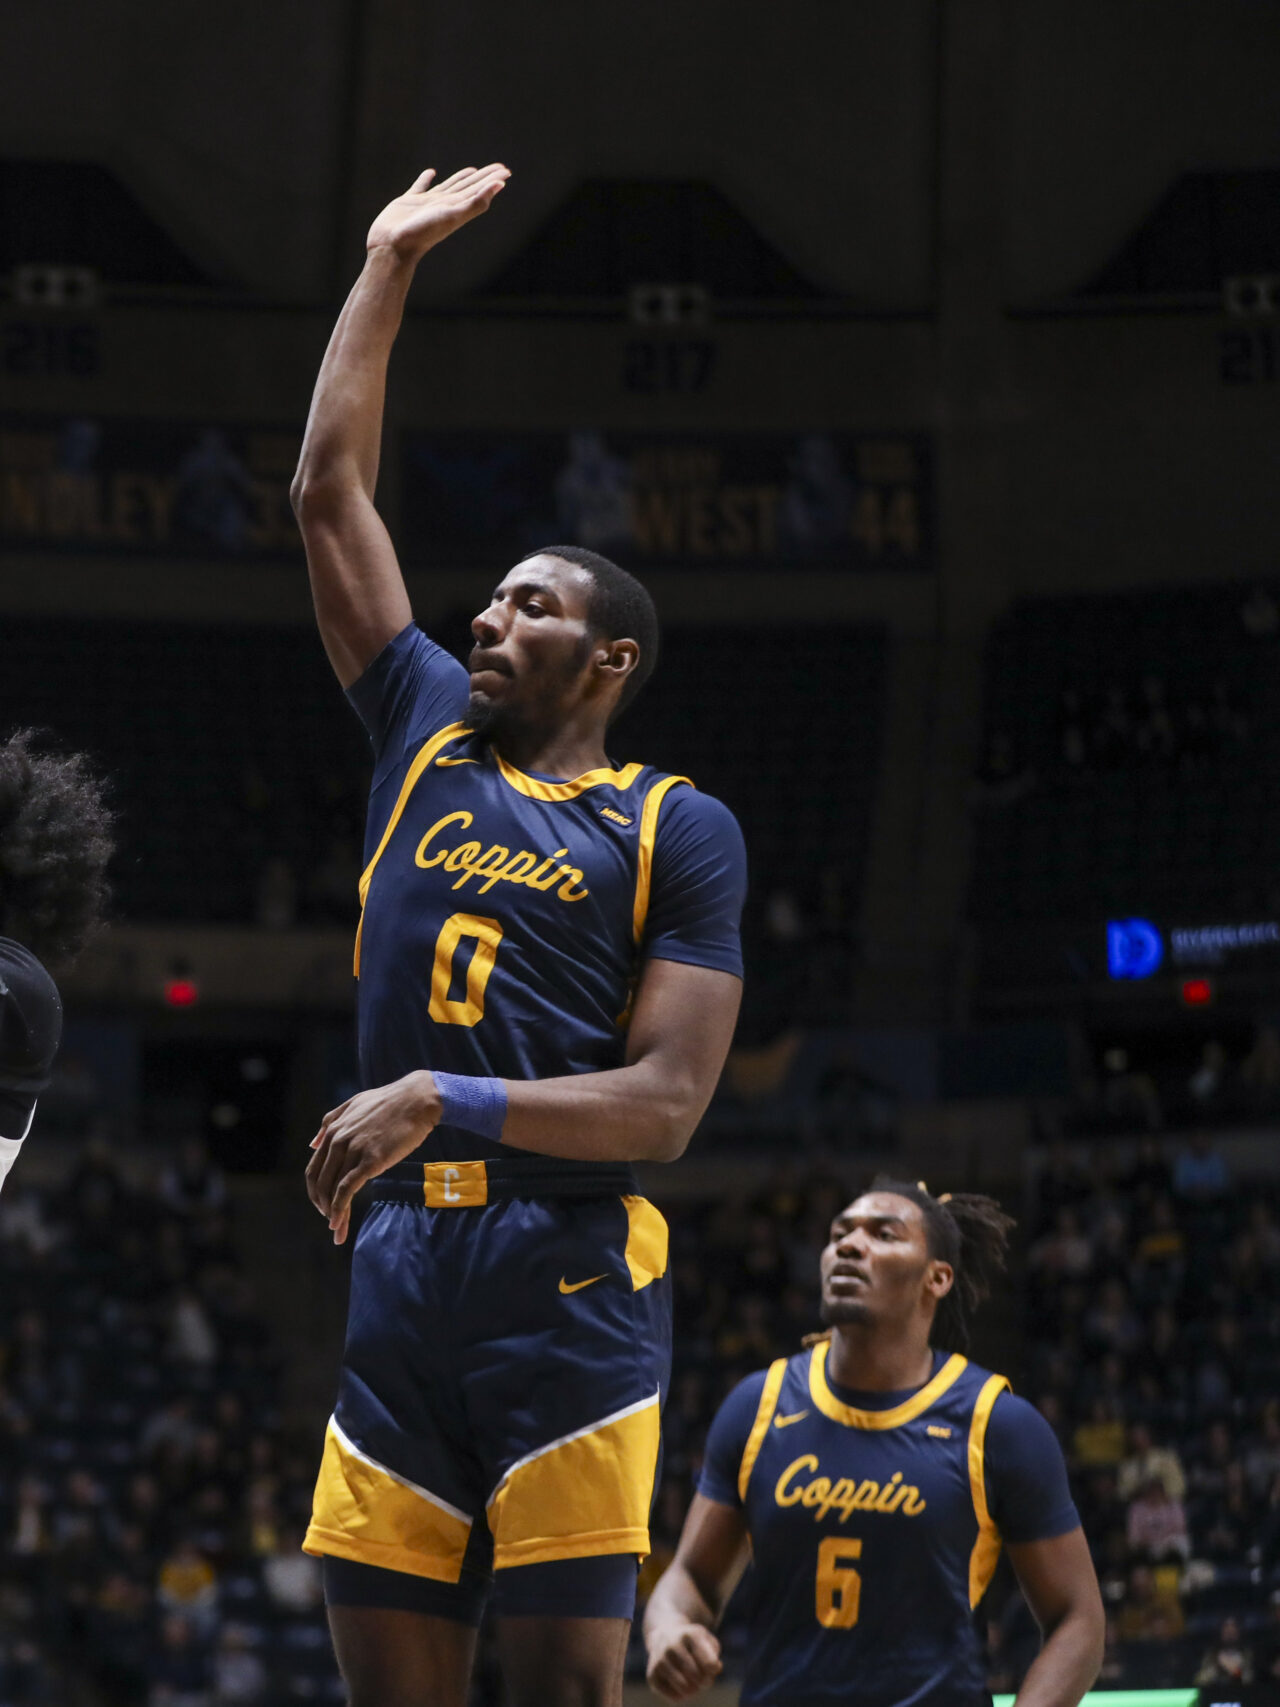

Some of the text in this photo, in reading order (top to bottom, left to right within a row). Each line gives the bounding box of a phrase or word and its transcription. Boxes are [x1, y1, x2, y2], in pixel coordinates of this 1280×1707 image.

[624, 338, 717, 393] 217
[633, 486, 779, 555] WEST
[850, 488, 918, 554] 44
[415, 811, 588, 901] Coppin
[428, 912, 503, 1027] 0
[444, 1168, 460, 1202] C
[775, 1454, 926, 1524] Coppin
[815, 1536, 862, 1629] 6
